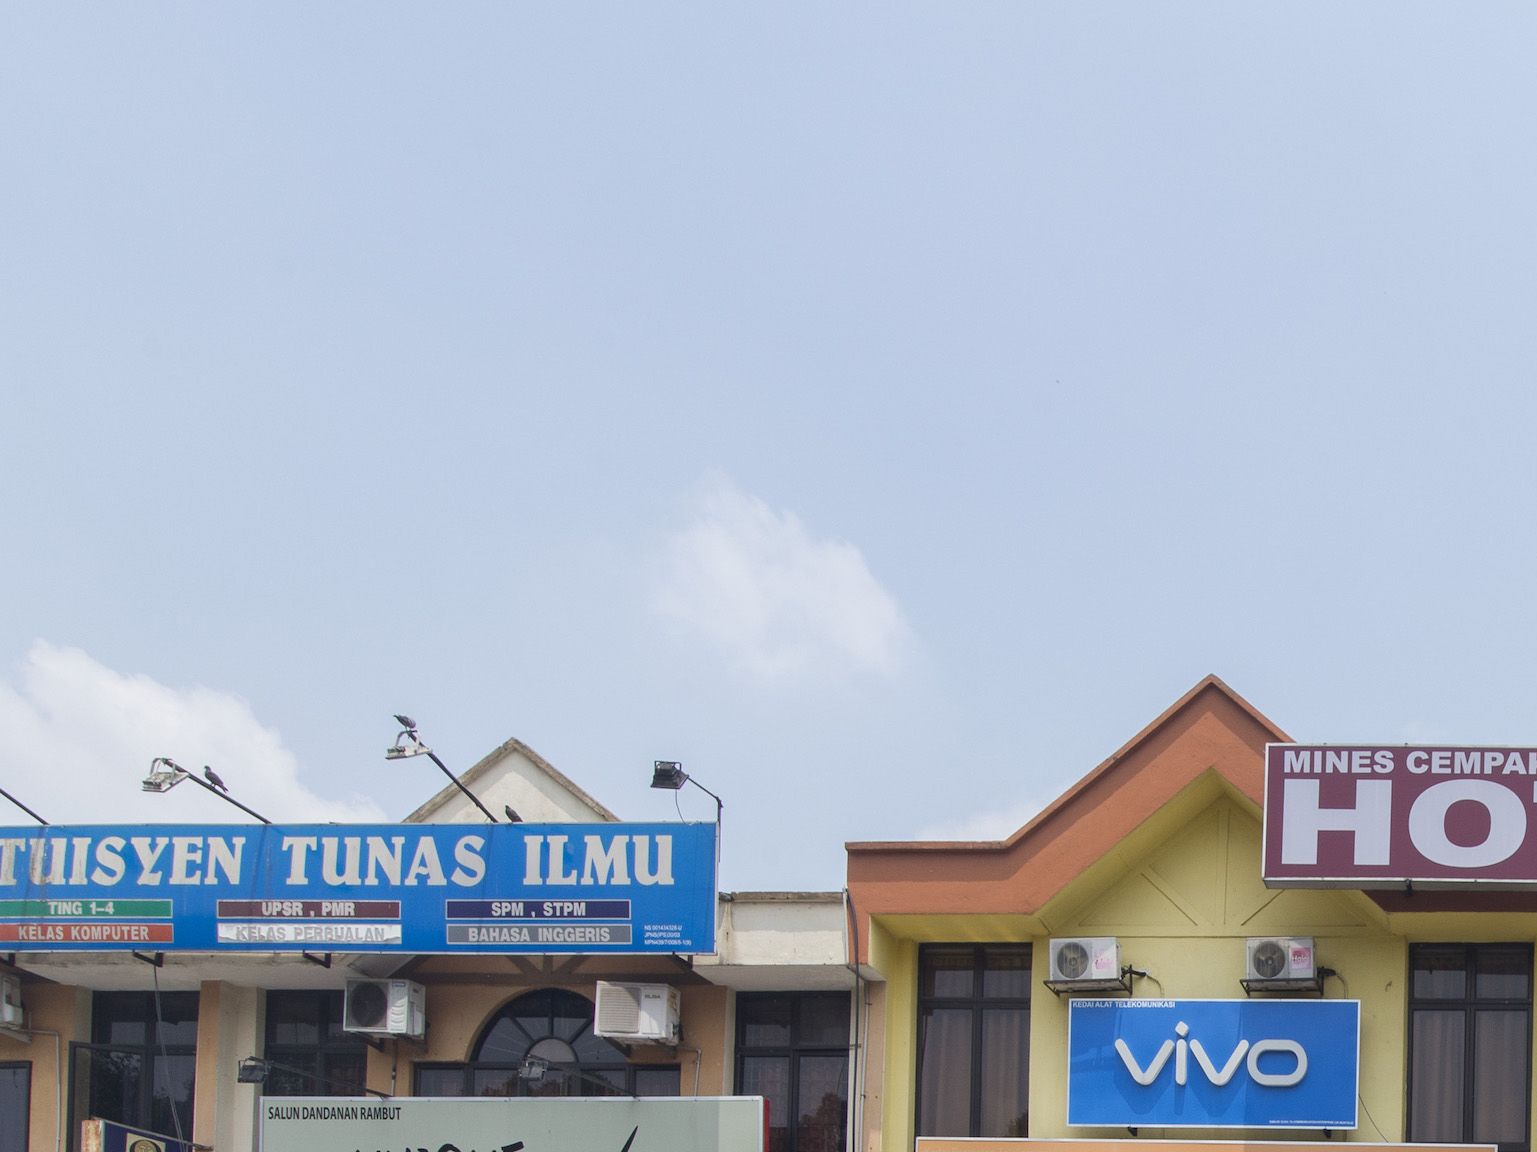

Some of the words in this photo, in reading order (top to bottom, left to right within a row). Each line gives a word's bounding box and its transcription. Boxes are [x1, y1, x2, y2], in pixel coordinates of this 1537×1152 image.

[1283, 750, 1395, 774] MINES
[0, 836, 246, 886] TUISYEN
[282, 835, 486, 887] TUNAS
[523, 835, 674, 886] ILMU
[48, 901, 82, 915] TING
[262, 902, 303, 916] UPSR
[322, 902, 355, 916] PMR
[491, 902, 524, 916] SPM
[543, 902, 586, 916] STPM
[18, 925, 63, 941] KELAS
[71, 925, 149, 941] KOMPUTER
[468, 927, 530, 942] BAHASA
[538, 927, 610, 942] INGGERIS
[1115, 1021, 1308, 1086] vivo
[268, 1107, 300, 1121] SALUN
[302, 1107, 358, 1121] DANDANAN
[360, 1107, 401, 1121] RAMBUT
